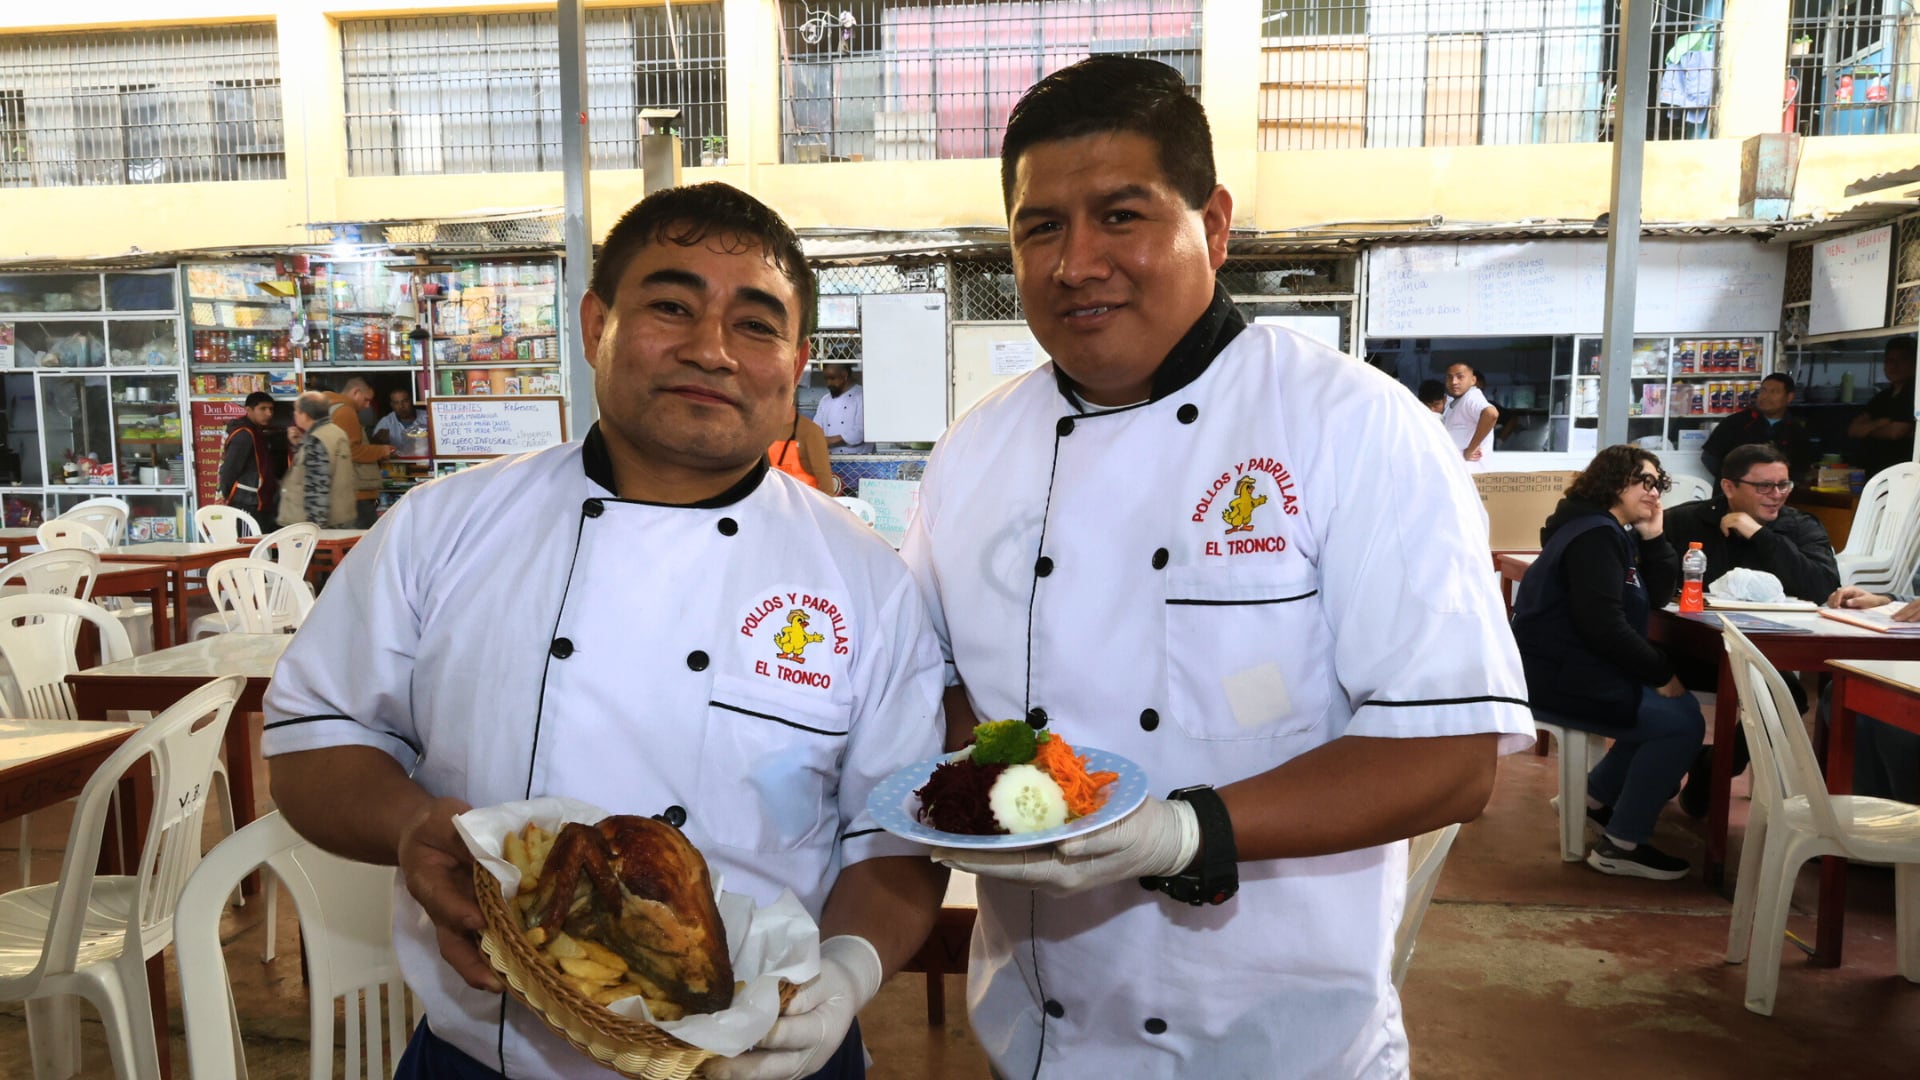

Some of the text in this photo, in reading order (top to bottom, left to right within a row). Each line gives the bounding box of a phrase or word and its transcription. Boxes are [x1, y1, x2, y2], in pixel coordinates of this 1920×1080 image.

[1192, 457, 1299, 522] POLLOS Y PARRILLAS
[1205, 536, 1287, 556] EL TRONCO
[740, 593, 848, 655] POLLOS Y PARRILLAS
[755, 660, 831, 689] EL TRONCO
